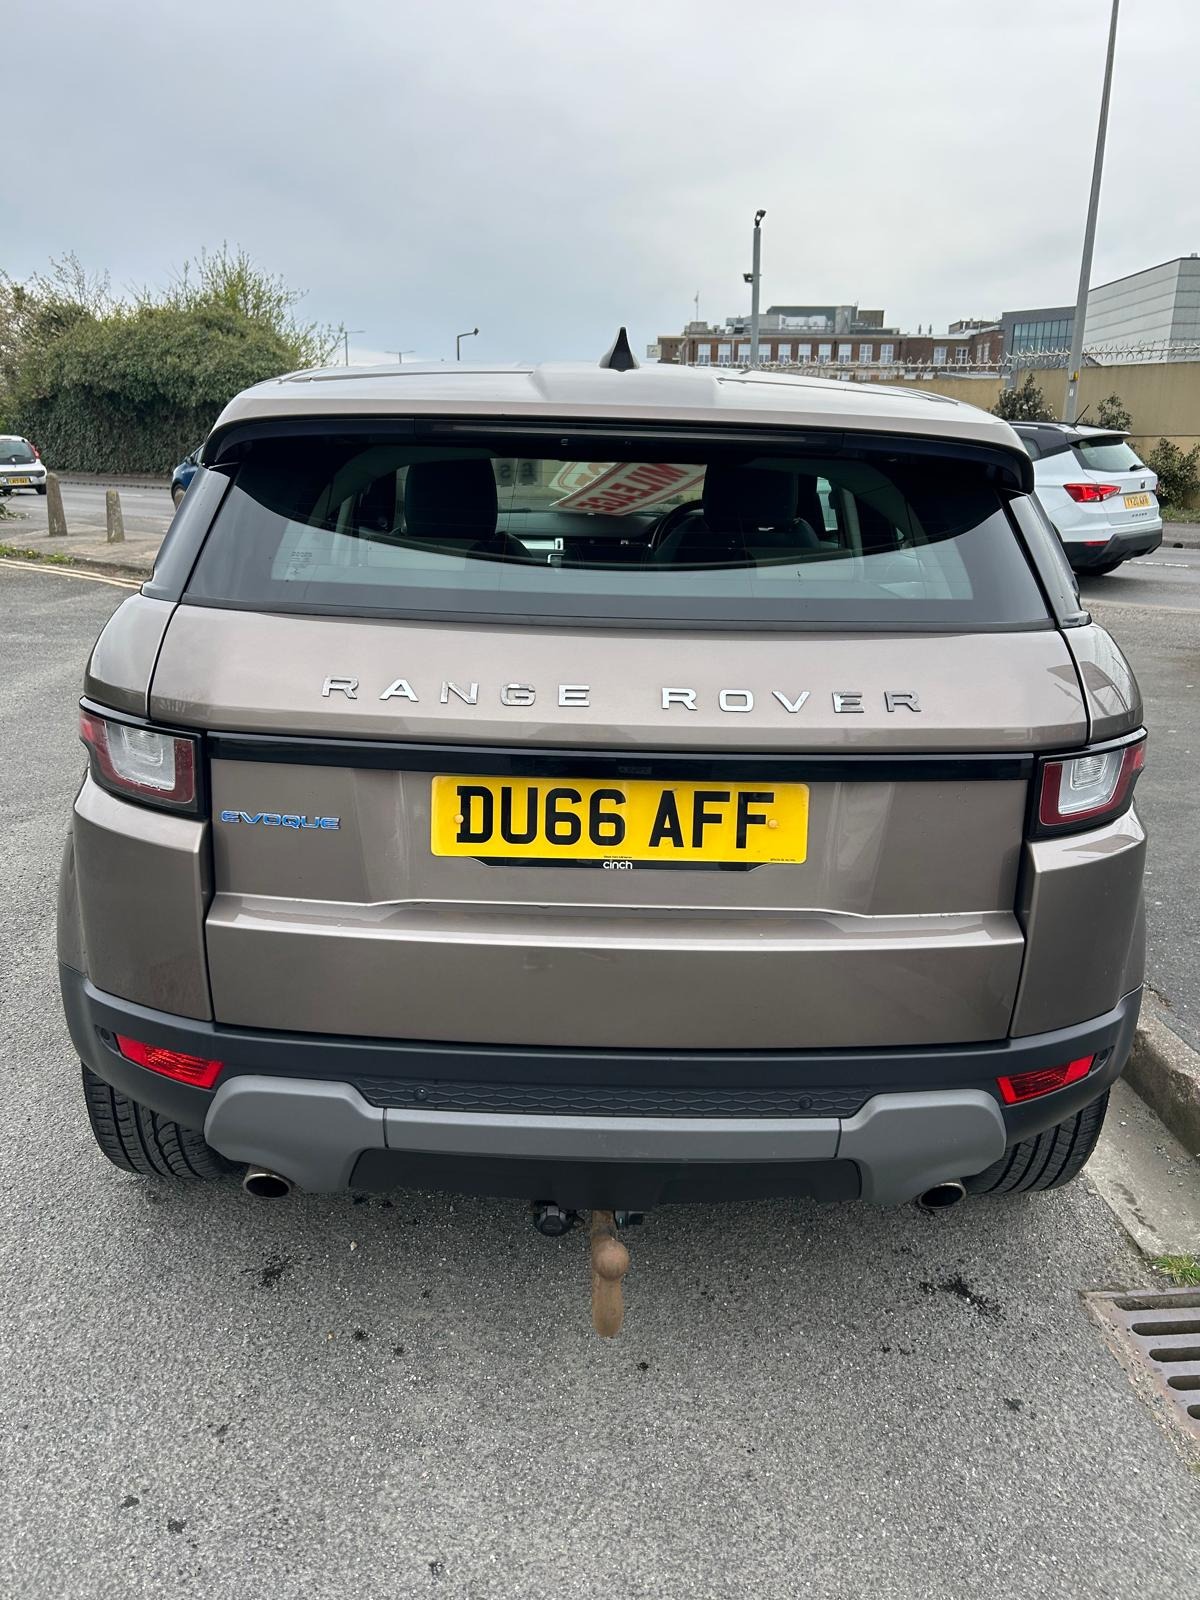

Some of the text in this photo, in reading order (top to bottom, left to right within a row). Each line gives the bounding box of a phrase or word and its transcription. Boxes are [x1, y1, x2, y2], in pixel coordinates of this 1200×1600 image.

[321, 674, 923, 714] RANGE ROVER
[221, 809, 341, 830] EVOQUE
[456, 785, 775, 849] DU66 AFF
[602, 859, 634, 870] cinch
